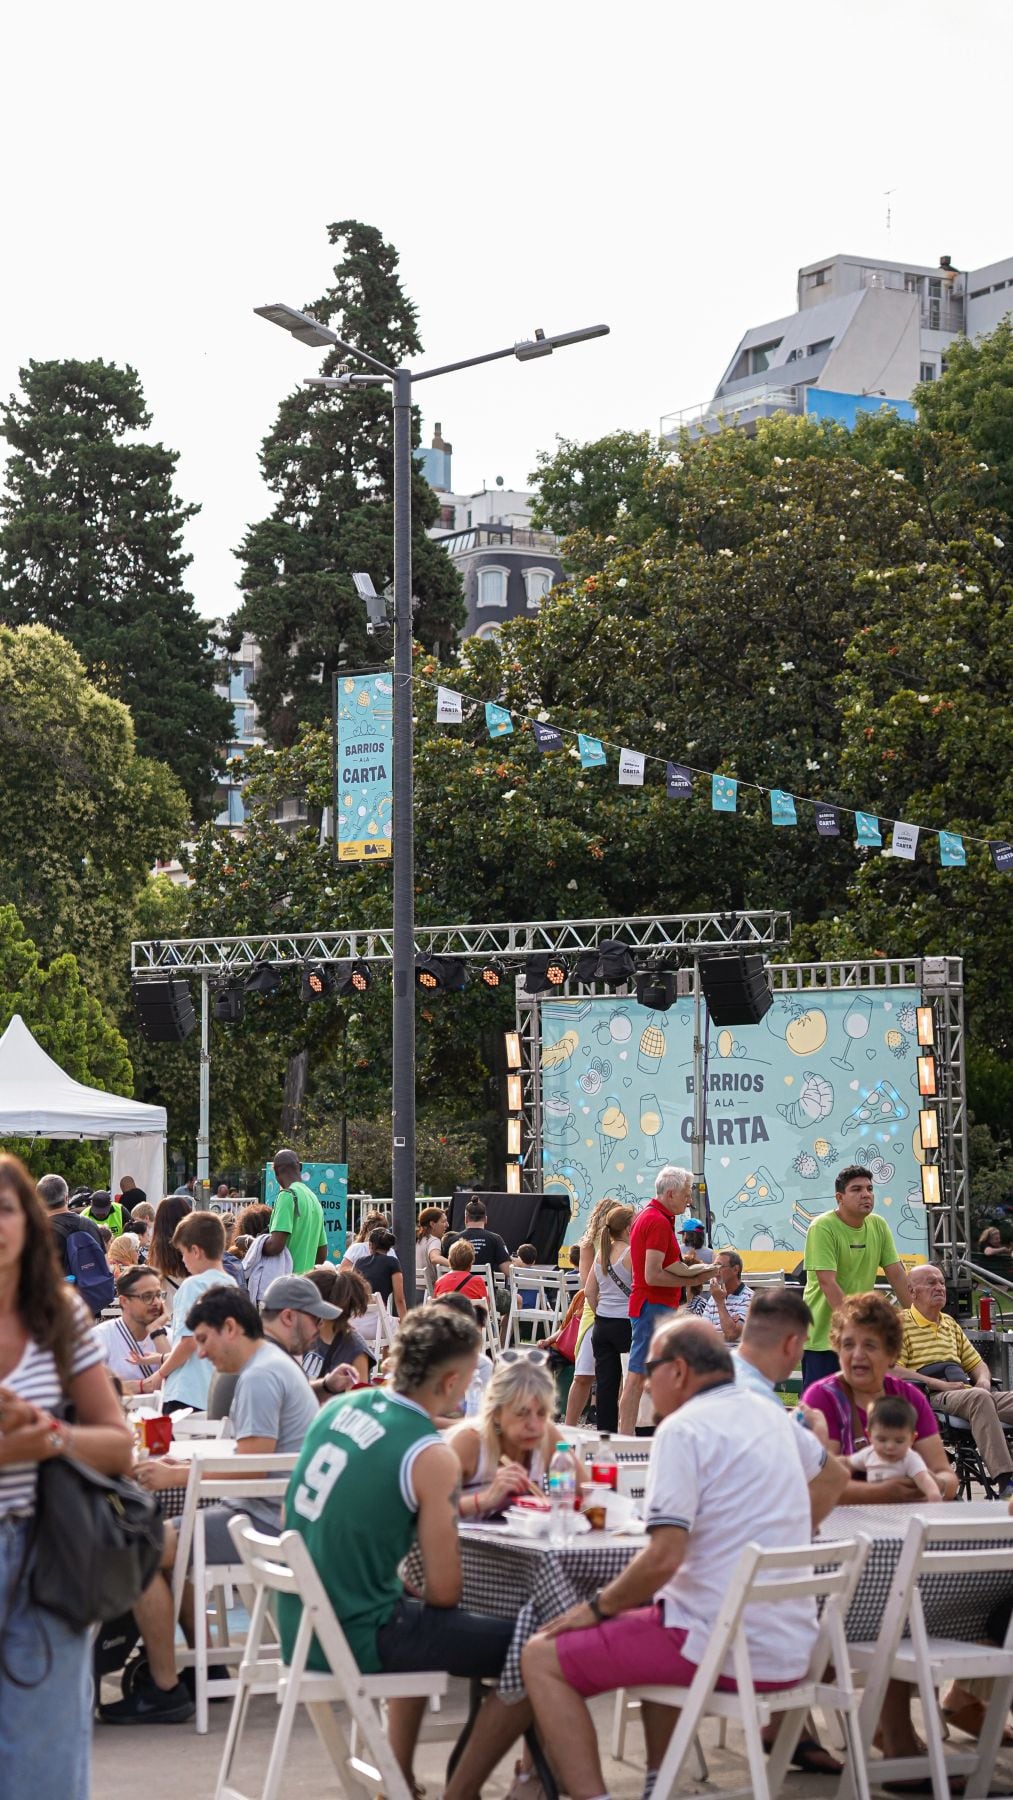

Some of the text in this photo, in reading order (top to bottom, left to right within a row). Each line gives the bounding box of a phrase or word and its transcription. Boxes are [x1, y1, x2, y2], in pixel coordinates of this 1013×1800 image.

[345, 742, 385, 757] BARRIOS
[342, 765, 387, 784] CARTA
[364, 844, 378, 855] BA
[714, 1098, 735, 1107] A LA
[293, 1441, 349, 1523] 9
